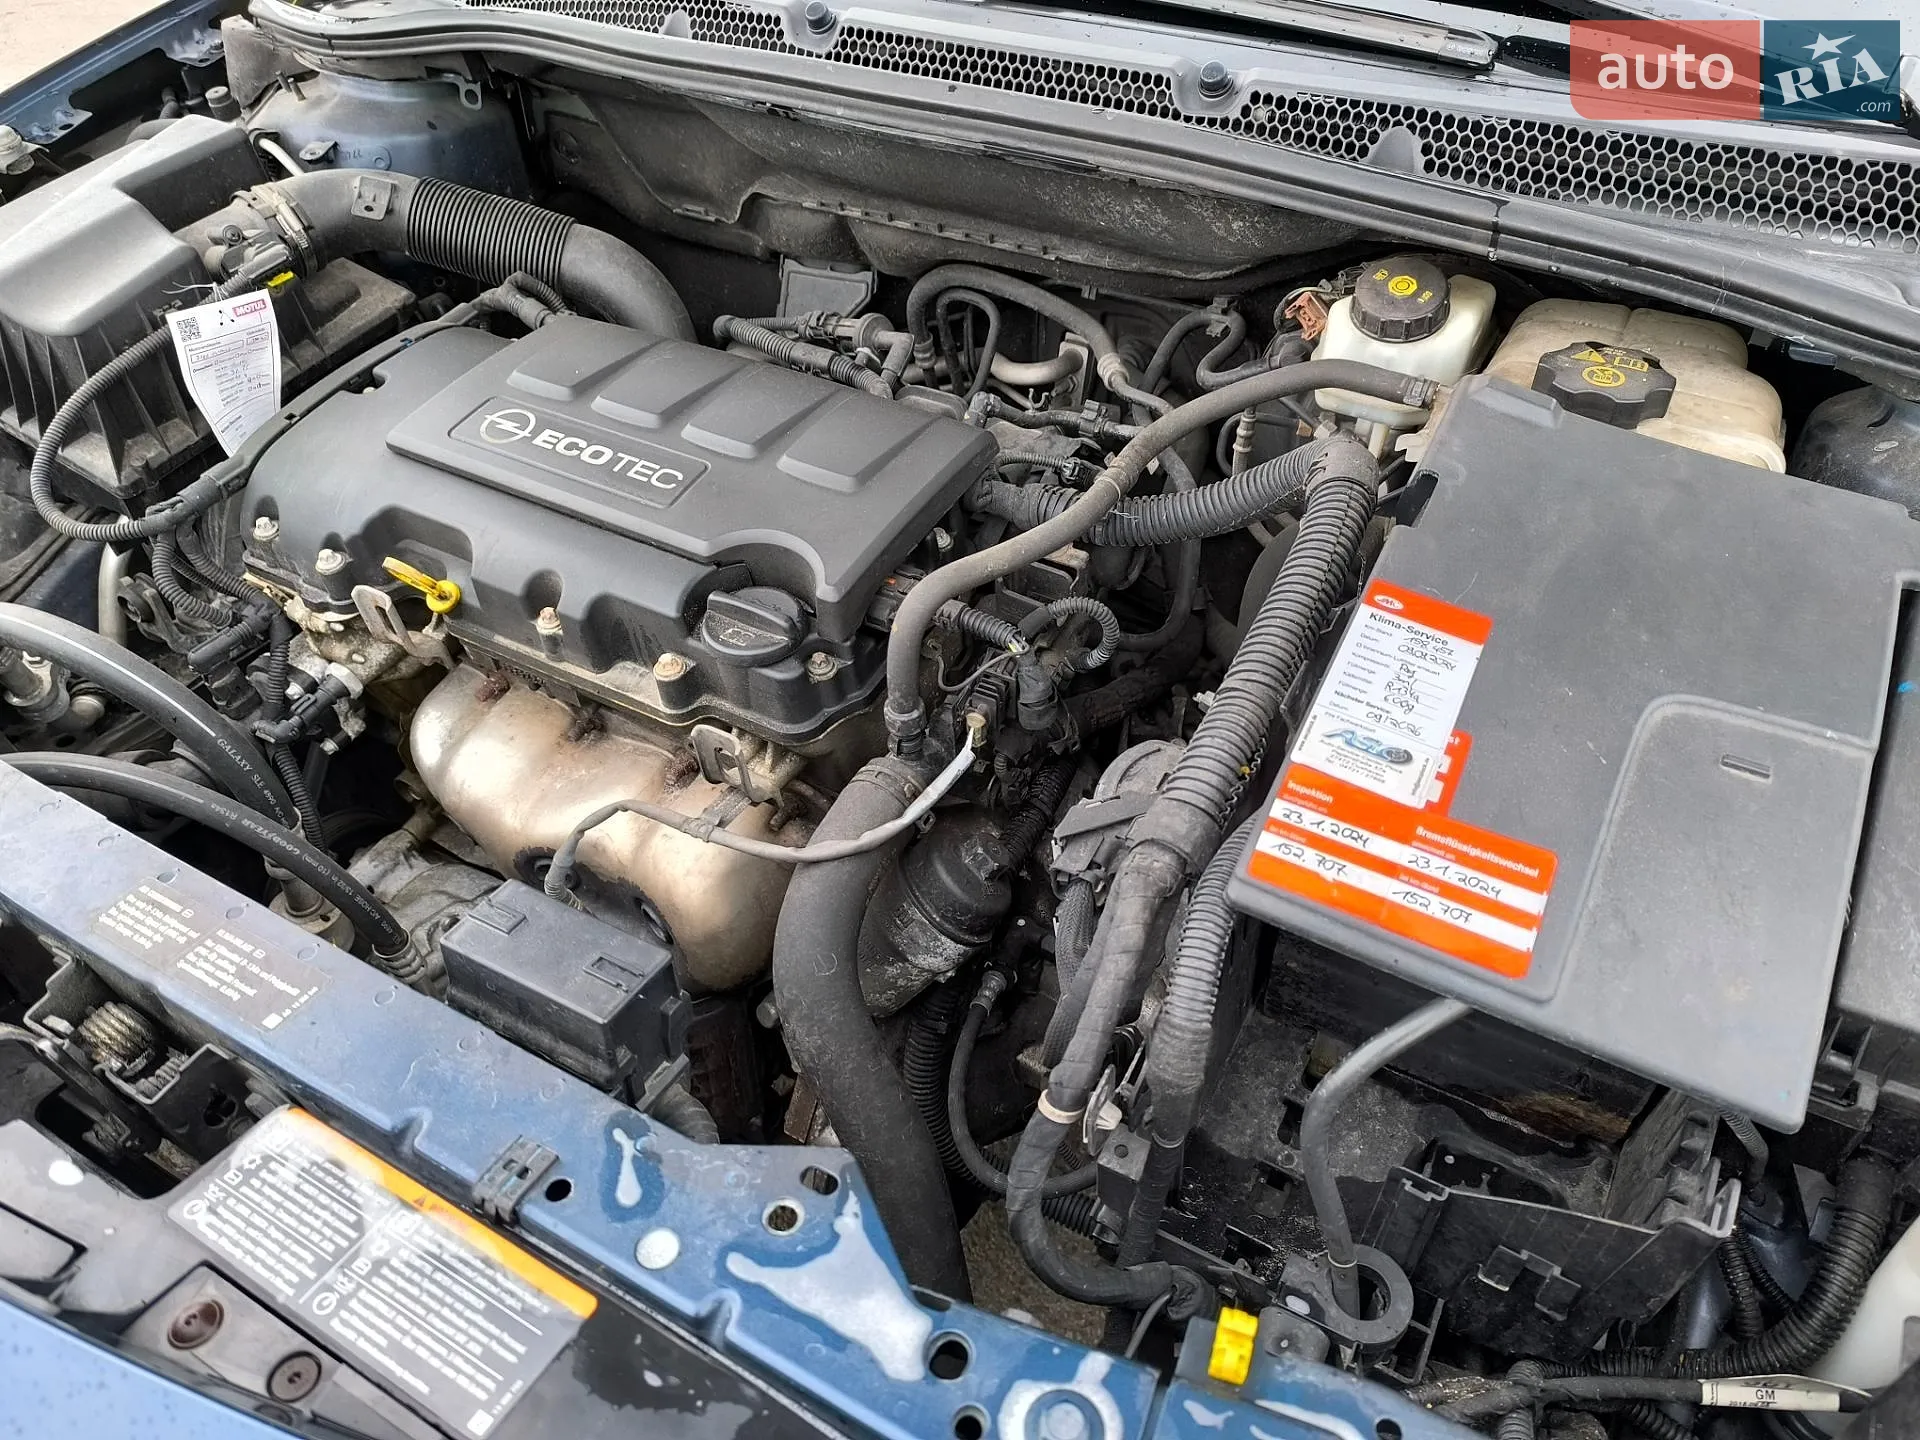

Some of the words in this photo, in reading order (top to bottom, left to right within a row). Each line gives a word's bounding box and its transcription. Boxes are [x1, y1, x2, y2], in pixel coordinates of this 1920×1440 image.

[234, 301, 266, 316] MOTUL
[531, 428, 684, 490] ECOTEC
[1369, 612, 1449, 646] Klima-Service
[217, 738, 253, 772] GALAXY
[1287, 780, 1334, 804] Inspektion
[241, 818, 300, 855] GOODYEAR
[1755, 1389, 1776, 1401] GM
